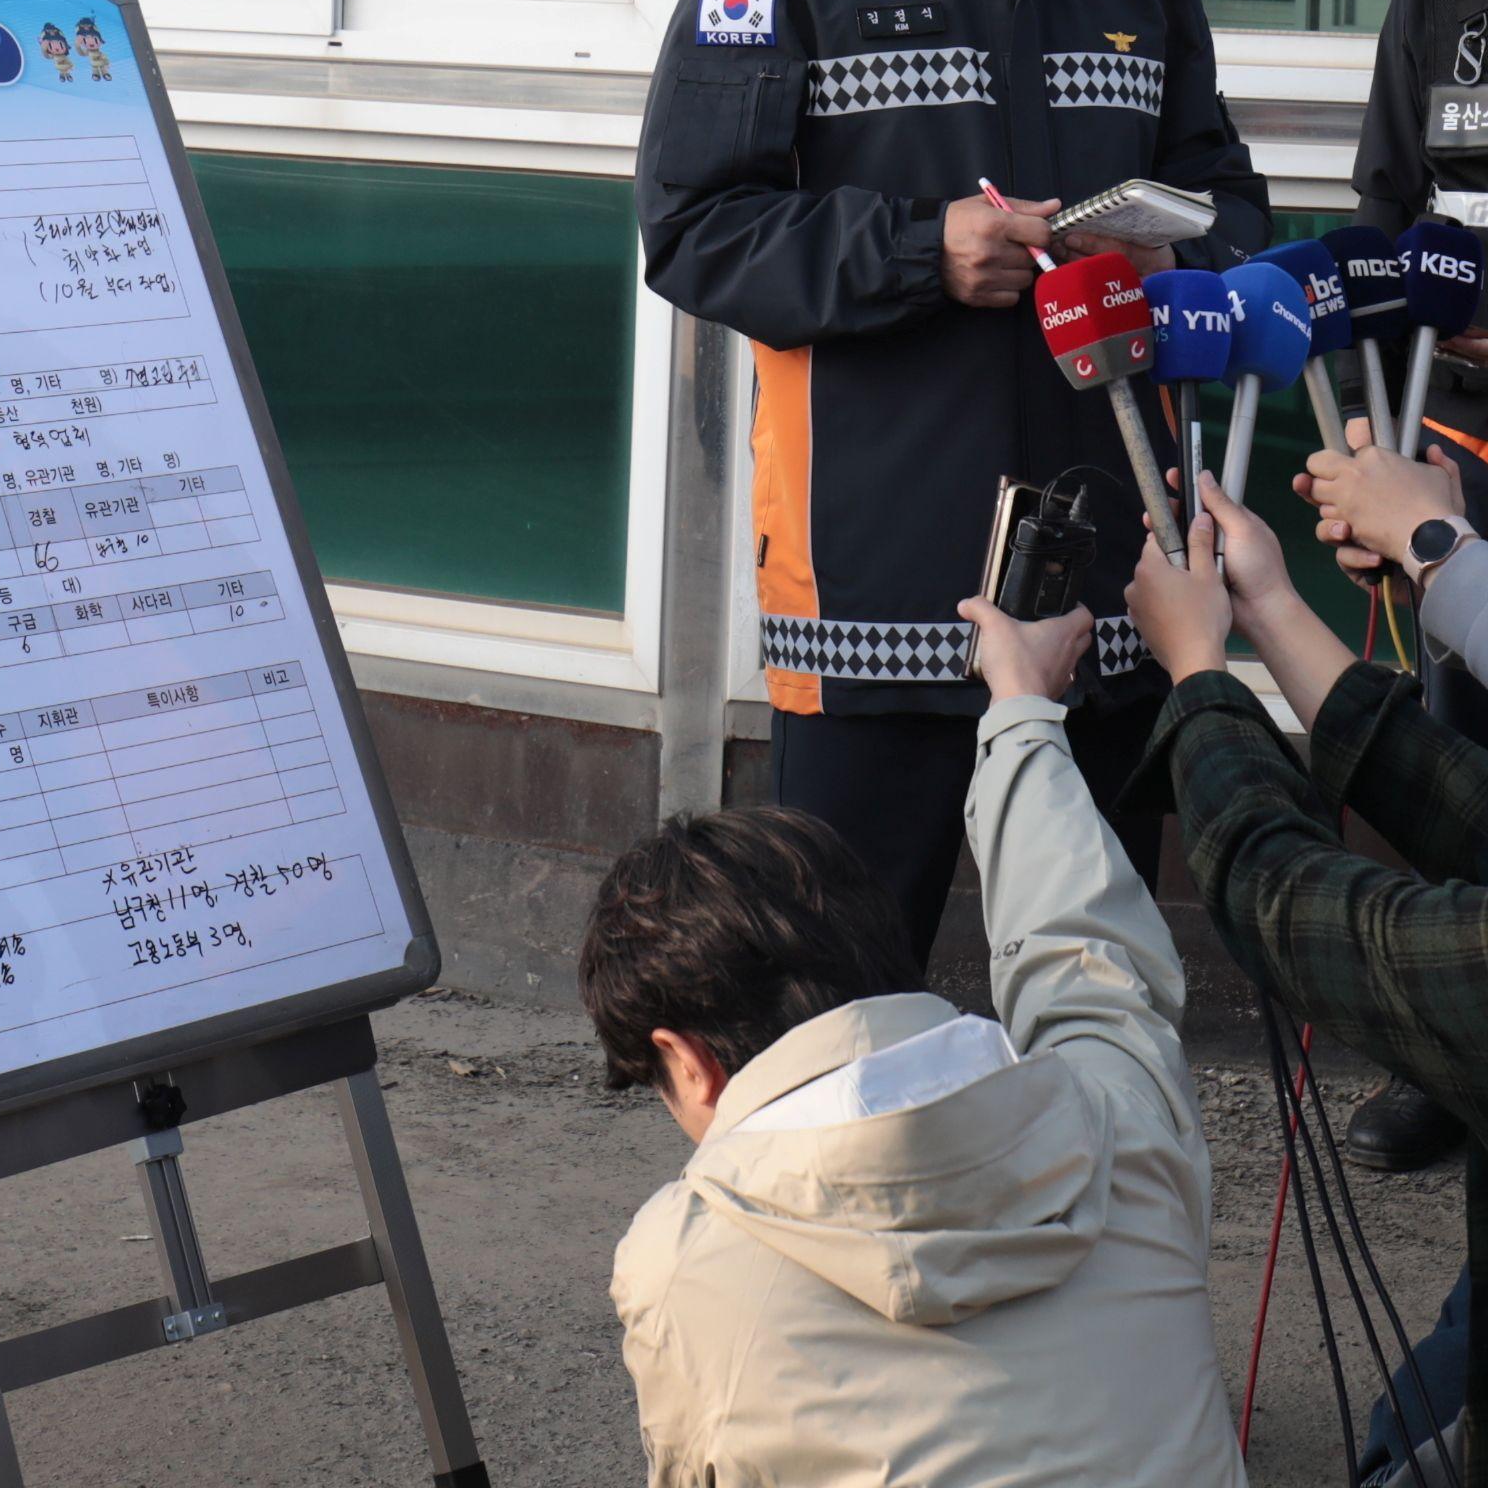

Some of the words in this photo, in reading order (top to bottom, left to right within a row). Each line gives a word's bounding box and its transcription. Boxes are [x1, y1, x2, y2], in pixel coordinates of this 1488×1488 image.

[895, 23, 909, 31] KIM
[707, 32, 766, 44] KOREA
[1421, 251, 1476, 283] KBS
[1105, 280, 1121, 293] TV
[1103, 288, 1144, 308] CHOSUN
[1043, 304, 1089, 330] CHOSUN
[1045, 301, 1058, 315] TV
[1182, 310, 1230, 332] YTN
[11, 379, 30, 395] 명,
[36, 374, 61, 390] 기타
[99, 368, 118, 385] 명)
[71, 396, 102, 413] 천원)
[26, 466, 76, 486] 유관기관
[118, 457, 143, 474] 기타
[179, 476, 206, 492] 기타
[85, 497, 140, 517] 유관기관
[28, 507, 57, 527] 경찰
[137, 533, 149, 547] 10
[217, 579, 244, 597] 기타
[75, 602, 103, 621] 화학
[132, 594, 173, 612] 사다리
[8, 614, 36, 632] 구급
[22, 635, 31, 653] 6
[263, 670, 289, 686] 비고
[147, 686, 200, 709] 특이사항
[39, 708, 79, 729] 지휘관
[113, 894, 166, 930] 남구청
[226, 865, 276, 897] 경찰
[128, 931, 203, 966] 고용노동부
